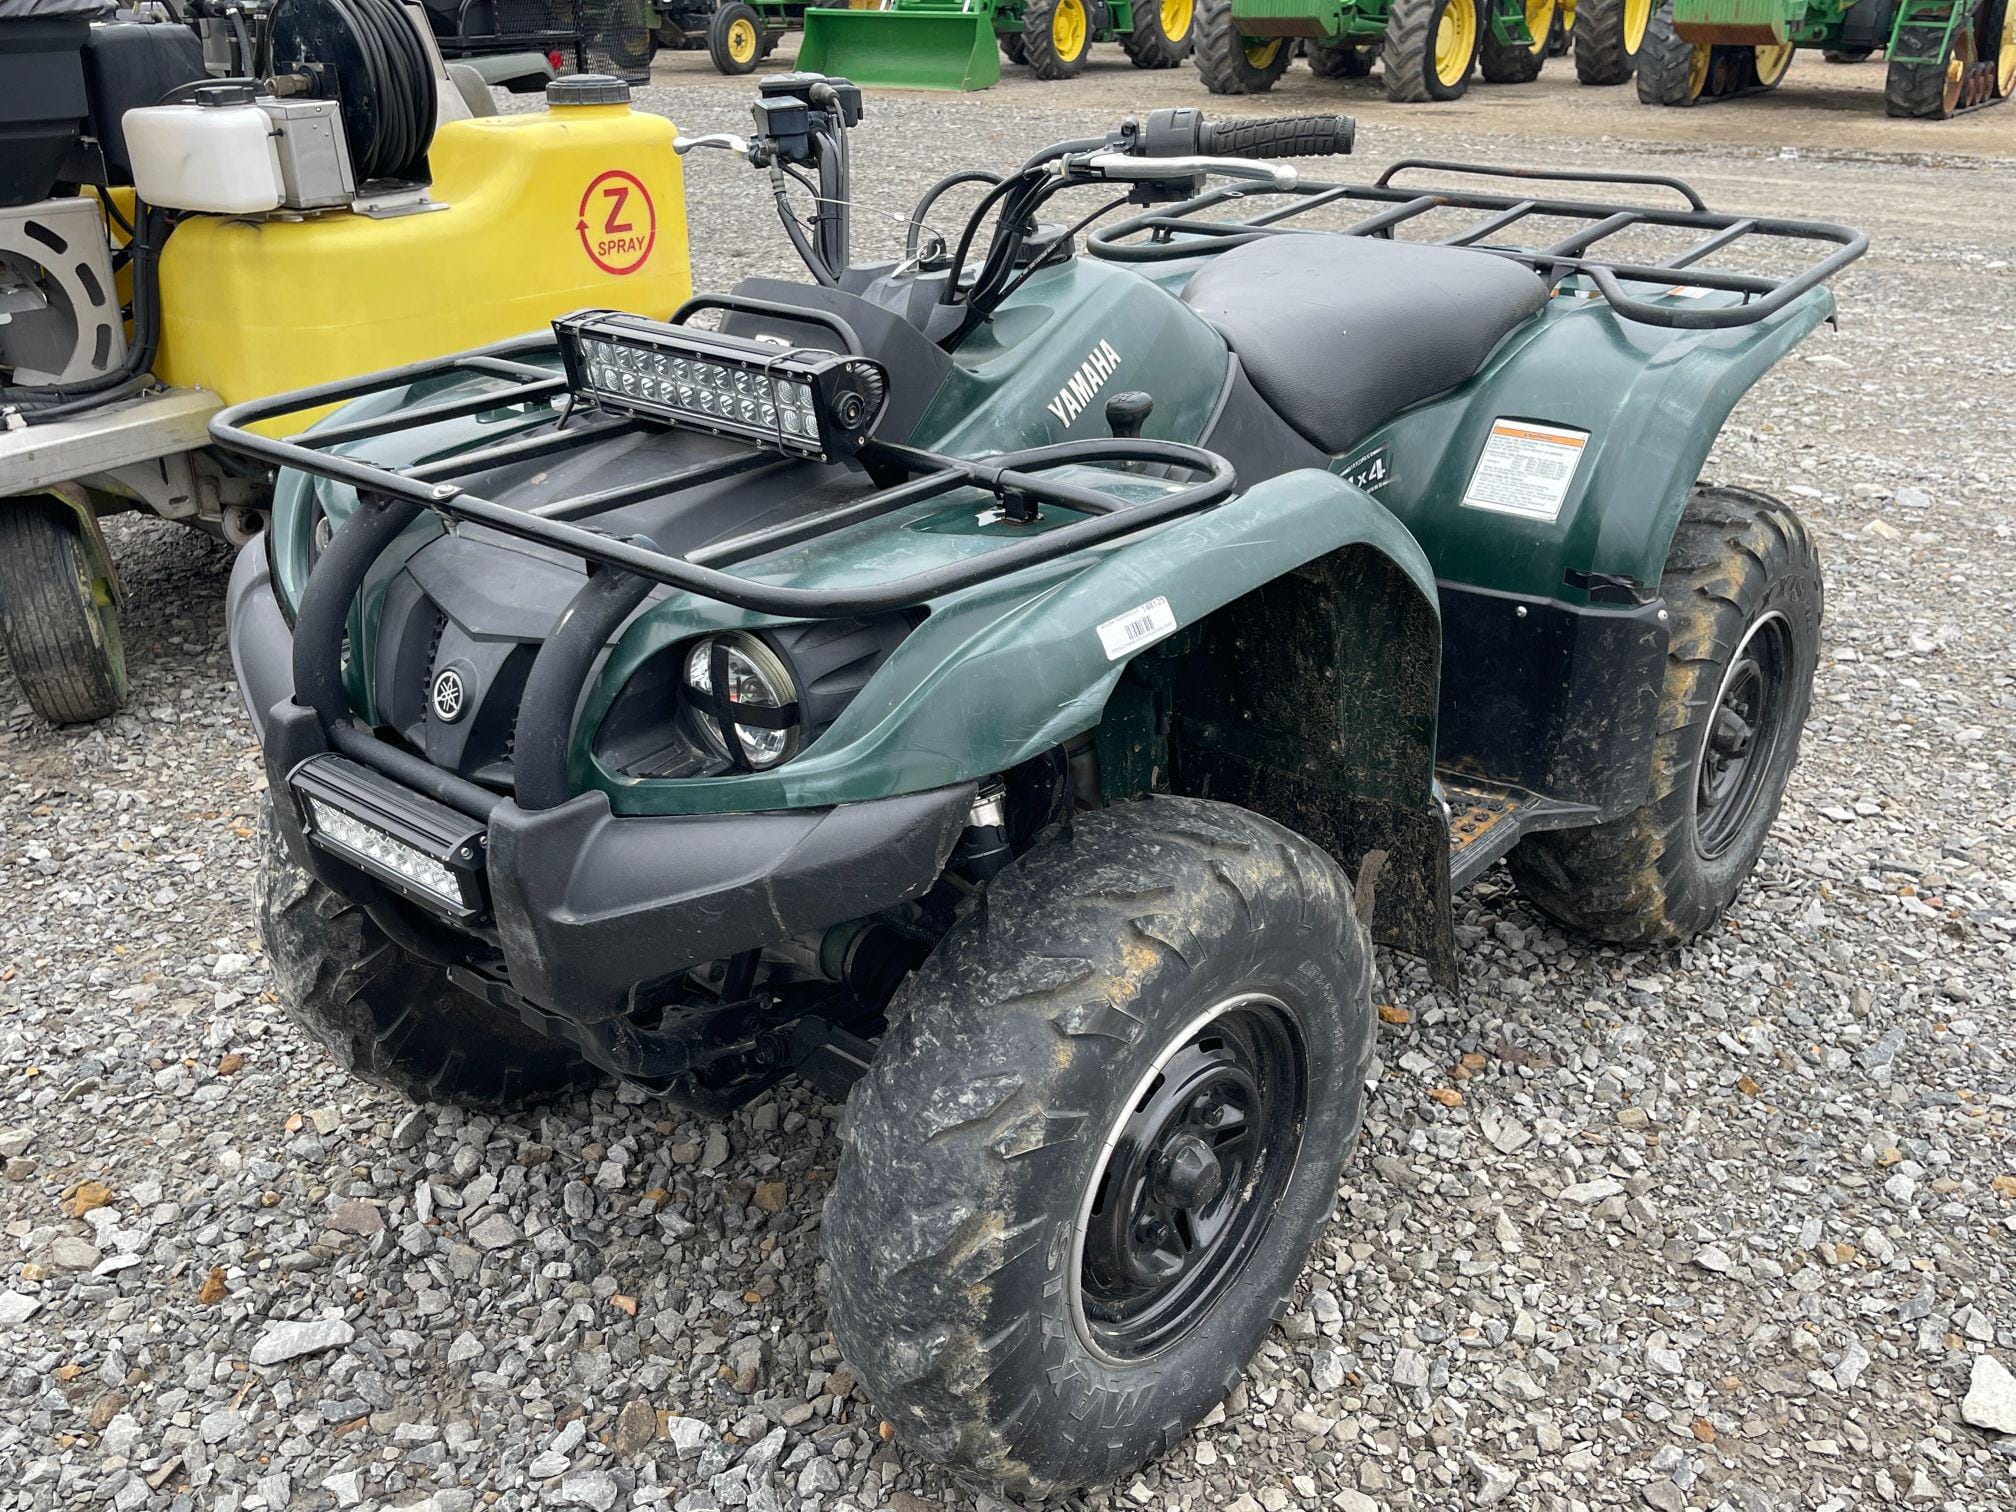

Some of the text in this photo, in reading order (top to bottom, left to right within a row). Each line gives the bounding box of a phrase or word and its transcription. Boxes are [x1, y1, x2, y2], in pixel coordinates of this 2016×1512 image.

[603, 187, 633, 234] Z
[598, 236, 645, 256] SPRAY
[1047, 338, 1122, 428] YAMAHA
[1349, 458, 1386, 487] x4
